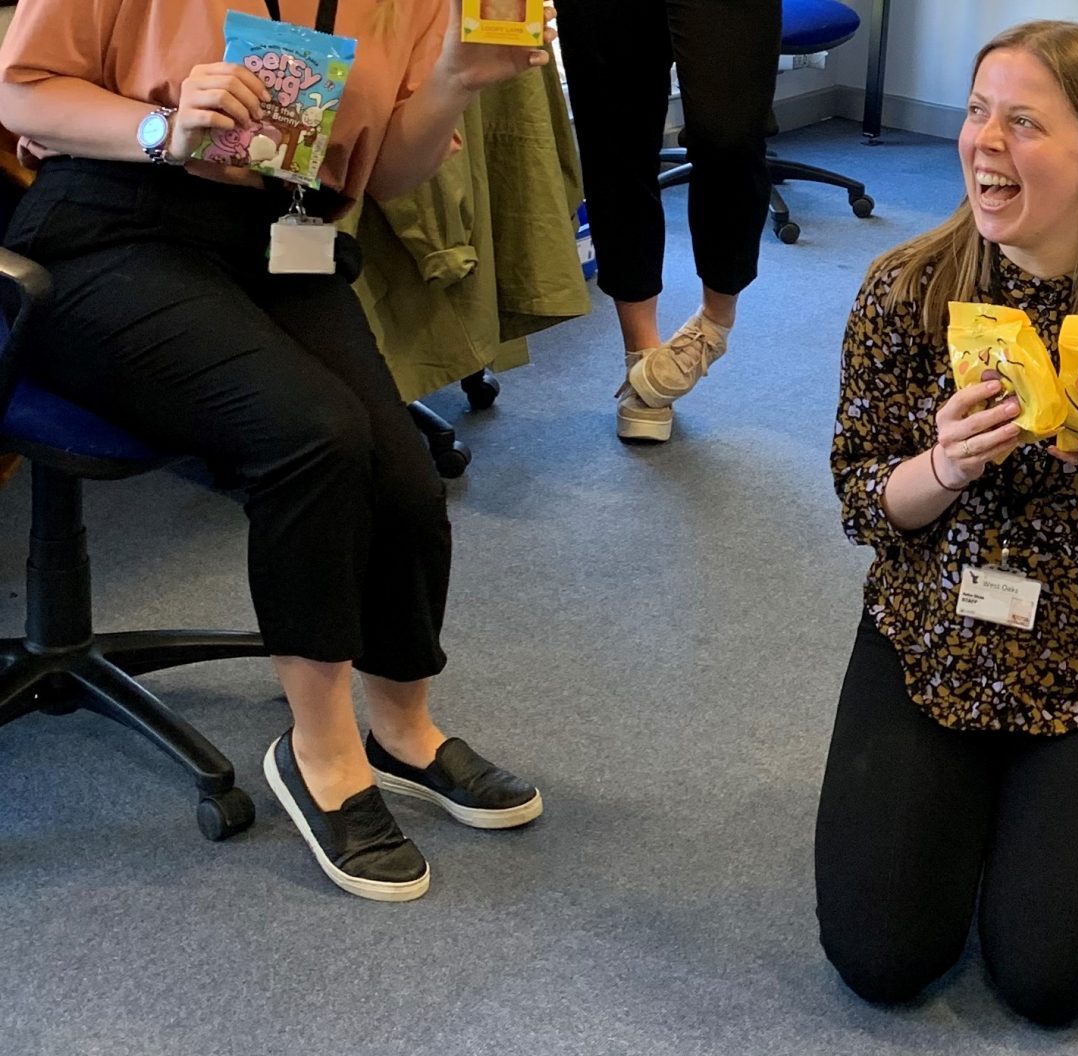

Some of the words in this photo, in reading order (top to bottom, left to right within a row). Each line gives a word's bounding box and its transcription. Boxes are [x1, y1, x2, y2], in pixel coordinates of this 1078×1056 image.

[243, 51, 322, 90] percy
[258, 68, 302, 107] pig
[272, 111, 300, 126] Bunny
[1002, 584, 1019, 594] Oaks
